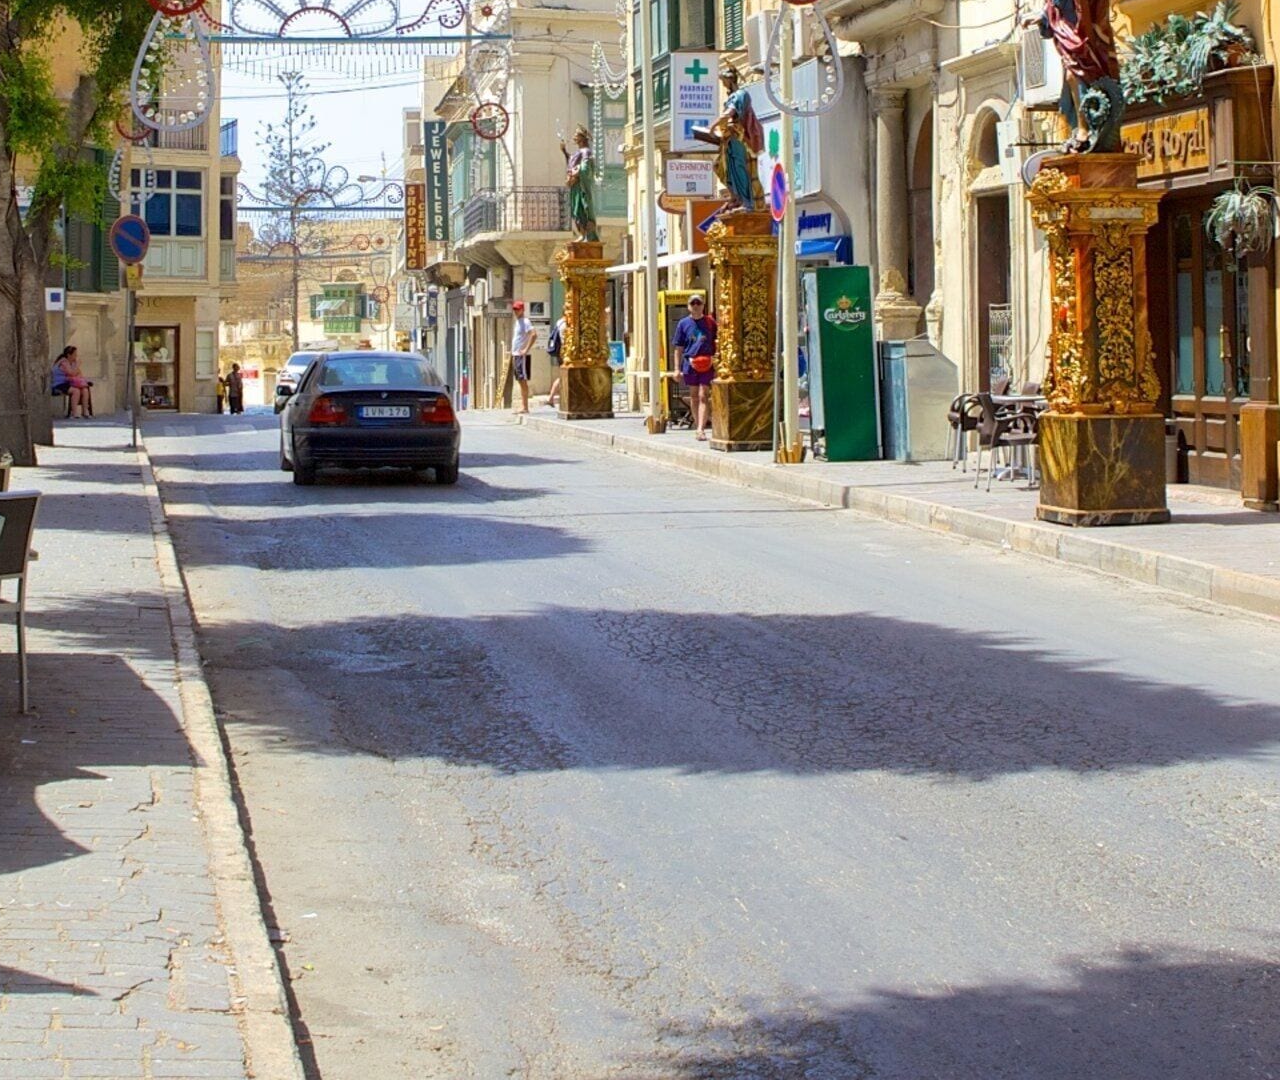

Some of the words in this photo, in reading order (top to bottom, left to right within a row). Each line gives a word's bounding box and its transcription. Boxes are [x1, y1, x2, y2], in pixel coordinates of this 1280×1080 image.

[1160, 119, 1207, 167] Royal
[430, 122, 444, 240] JEWELLERS
[407, 185, 418, 268] SHOPPING
[824, 307, 865, 324] Carlsberg
